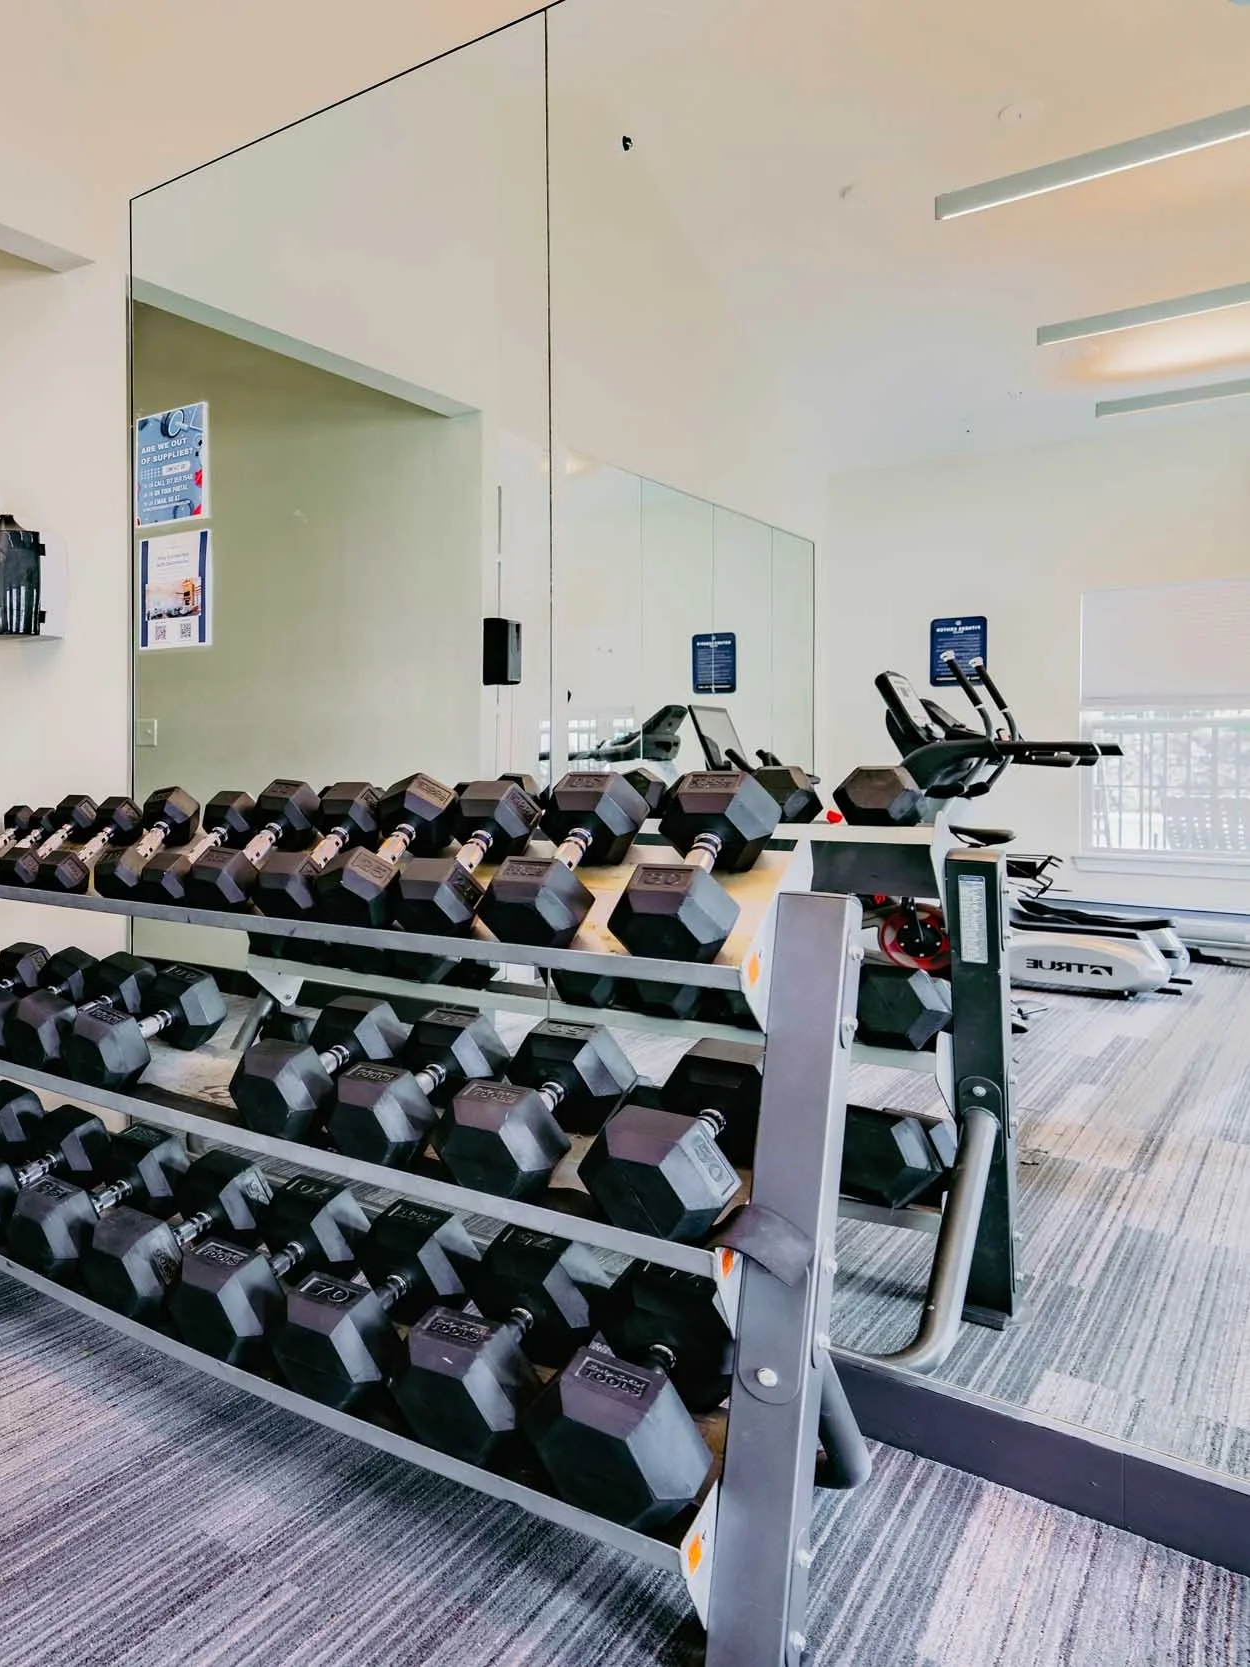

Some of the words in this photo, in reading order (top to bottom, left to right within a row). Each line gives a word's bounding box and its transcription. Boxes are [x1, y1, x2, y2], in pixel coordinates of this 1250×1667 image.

[141, 445, 156, 454] ARE
[158, 441, 169, 450] WE
[171, 437, 187, 447] OUT
[141, 457, 150, 465] OF
[310, 1283, 350, 1302] 70
[431, 1321, 479, 1343] TOOLS
[582, 1368, 643, 1398] TOOLS
